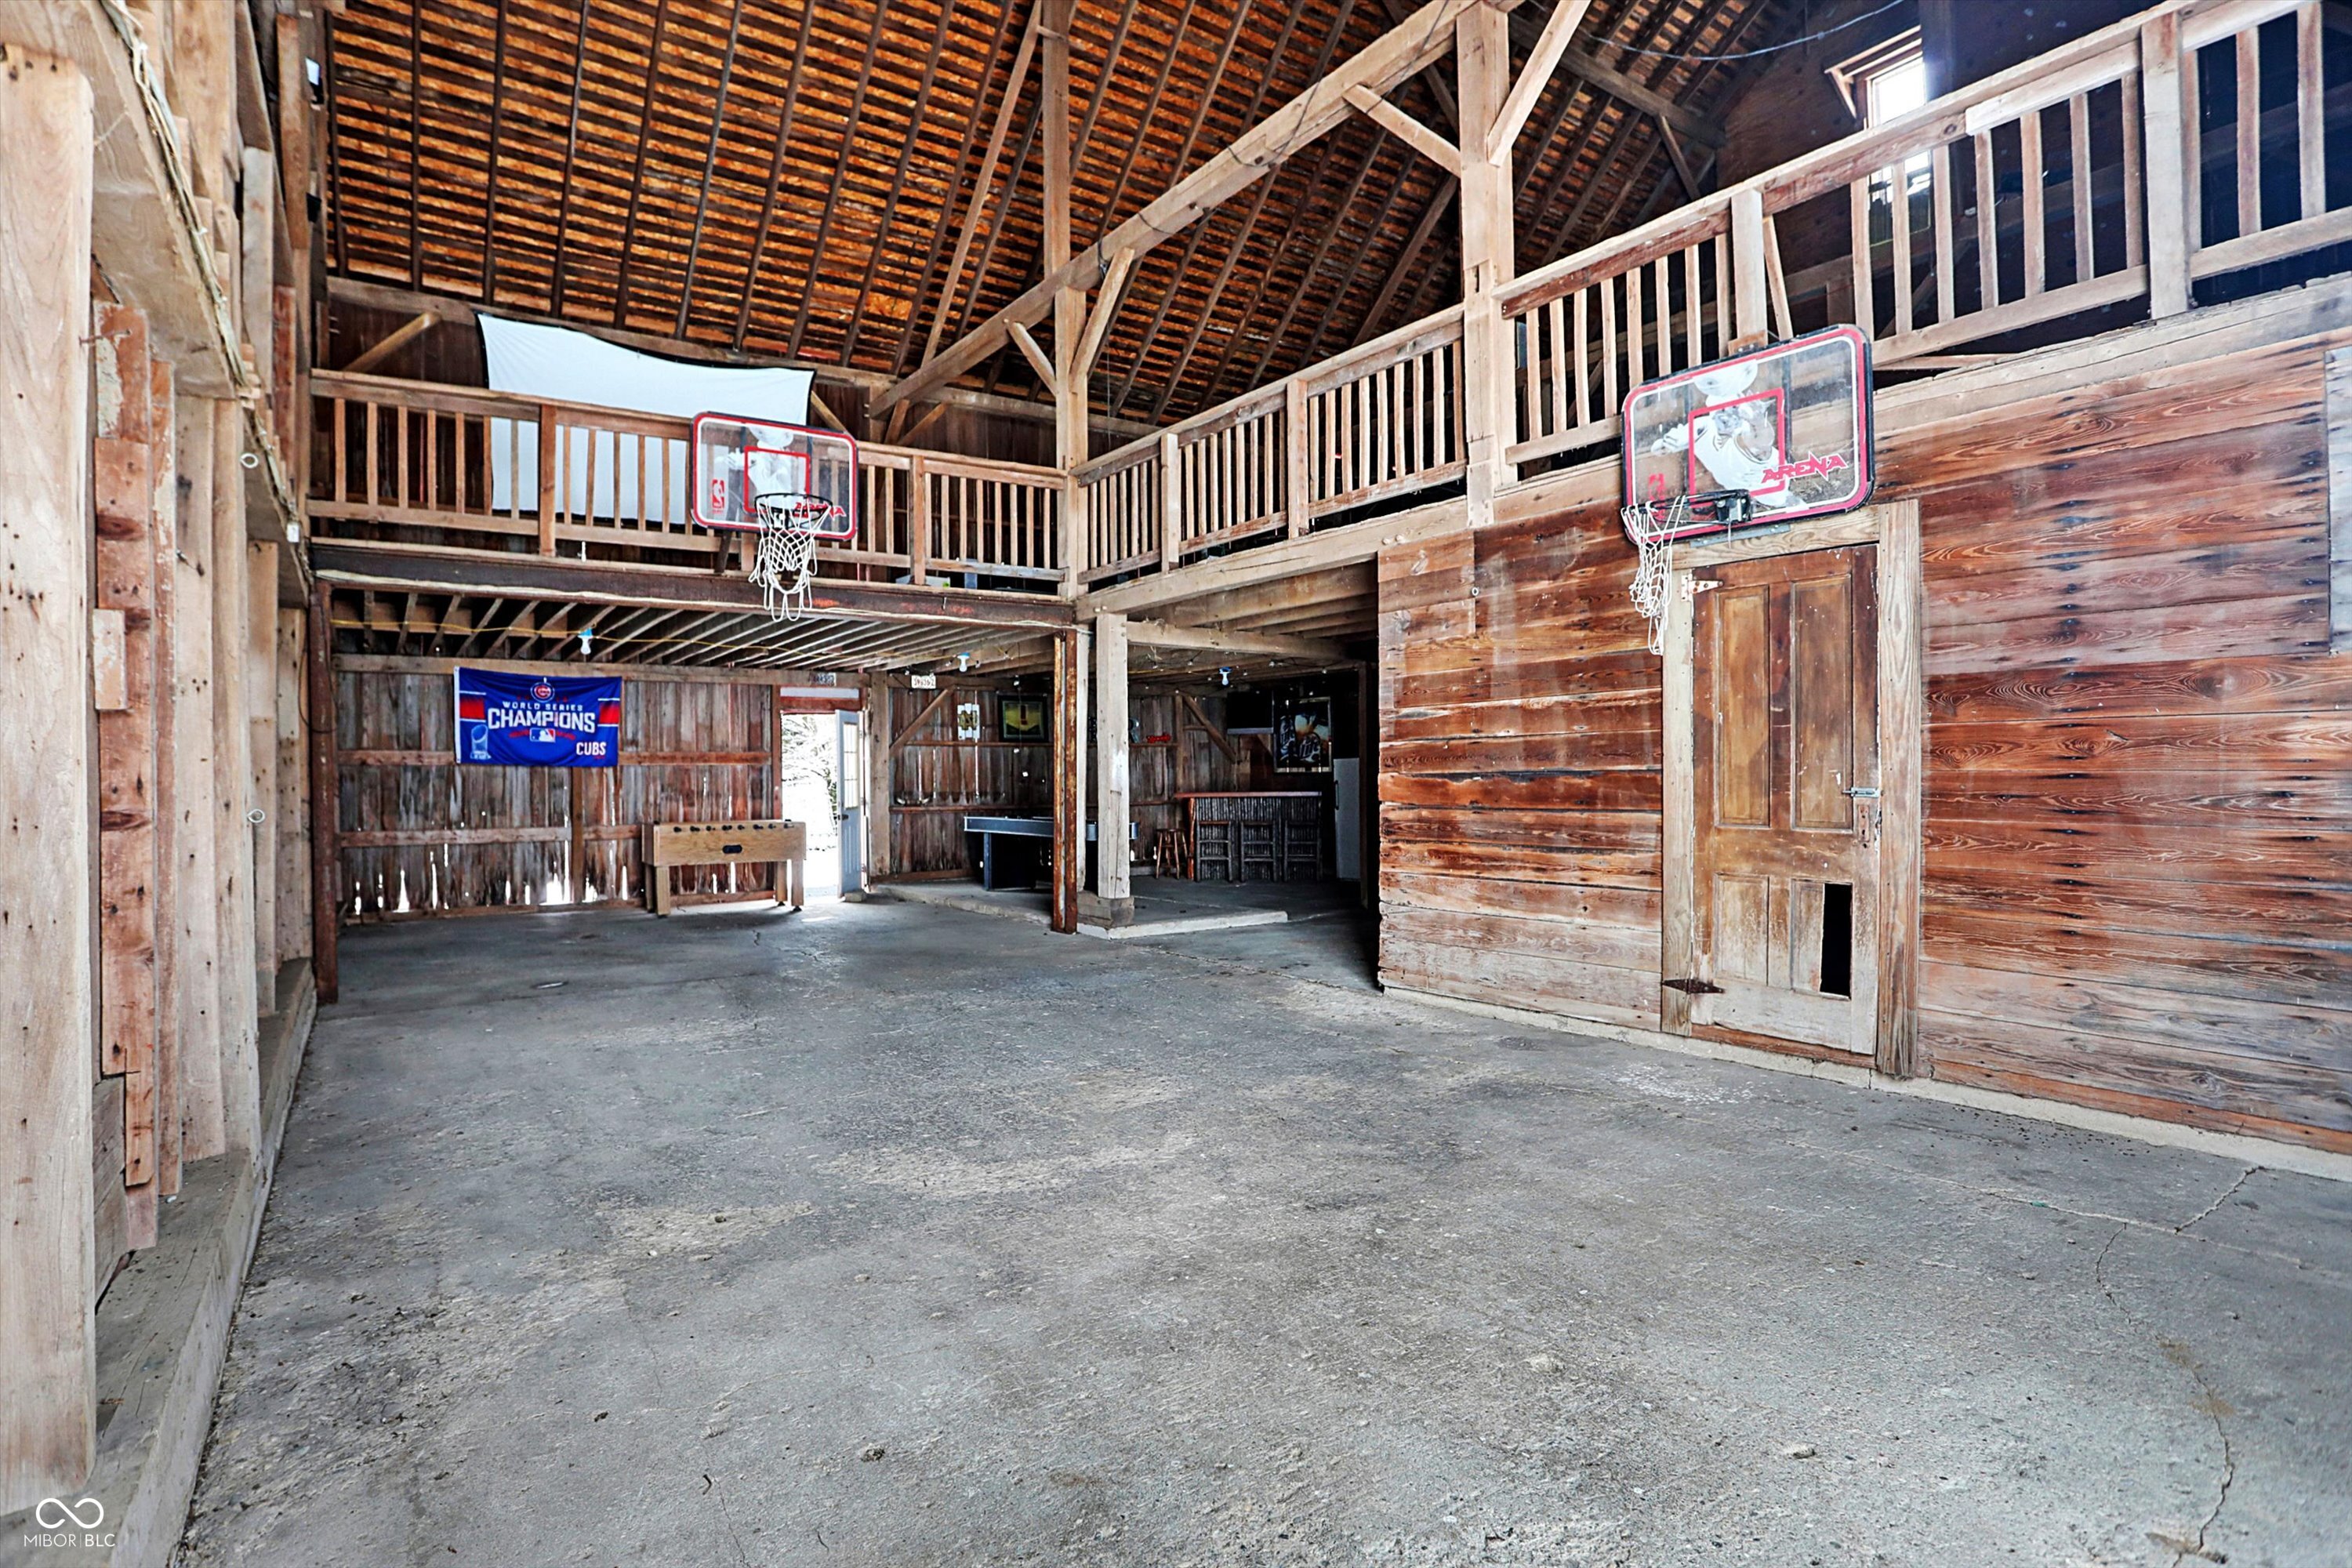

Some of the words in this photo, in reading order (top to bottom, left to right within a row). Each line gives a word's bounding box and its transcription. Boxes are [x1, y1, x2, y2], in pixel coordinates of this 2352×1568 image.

[1761, 452, 1849, 484] ARENA
[503, 701, 541, 710] WORLD
[488, 708, 595, 733] CHAMPIONS
[576, 742, 607, 755] CUBS
